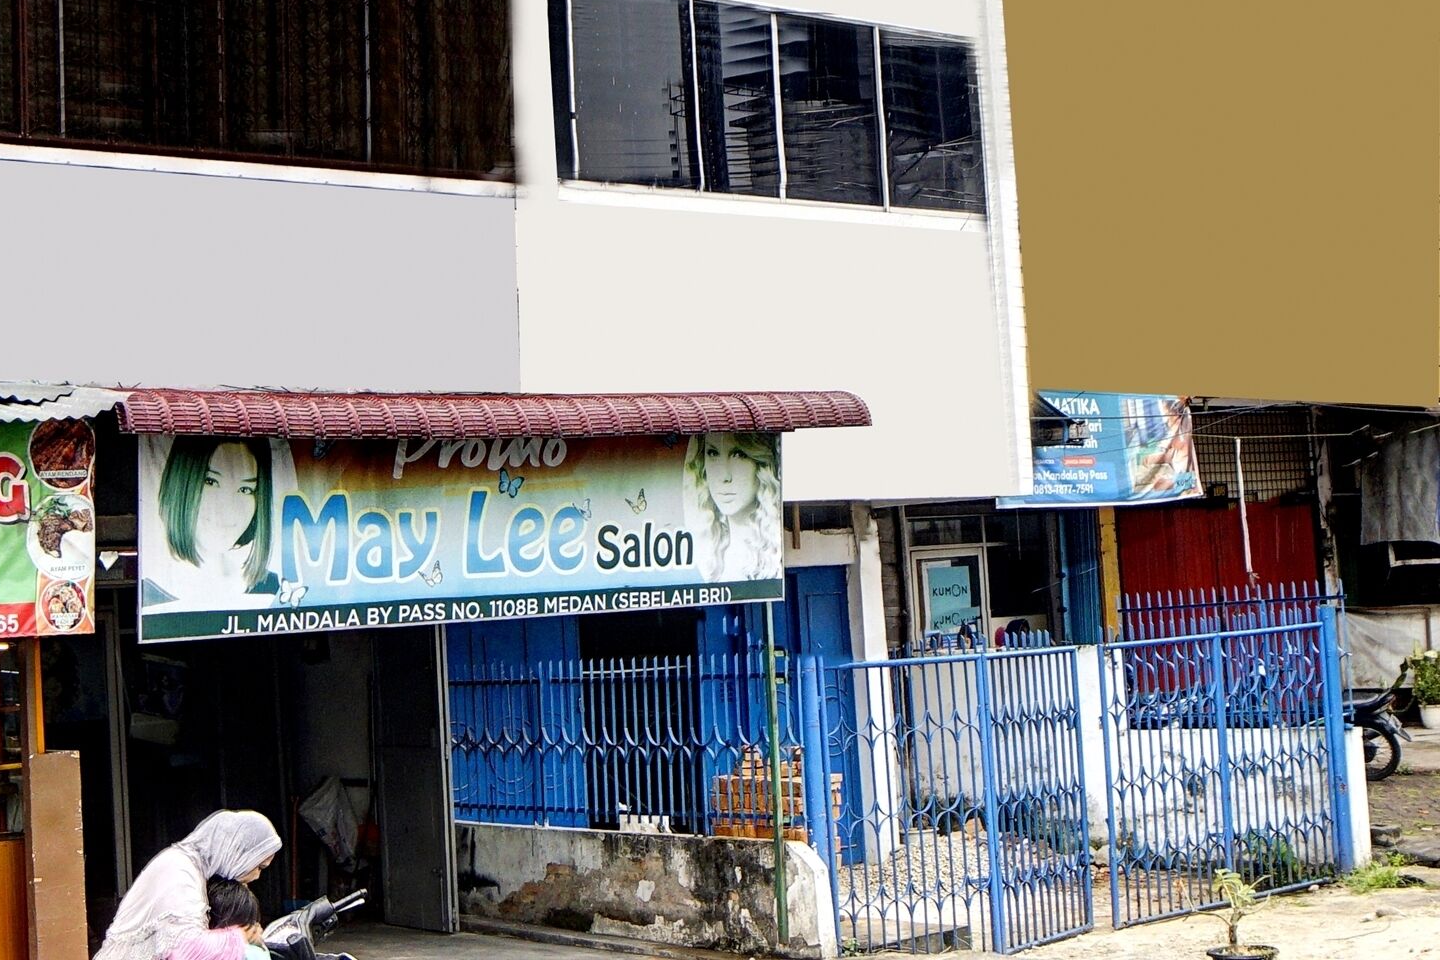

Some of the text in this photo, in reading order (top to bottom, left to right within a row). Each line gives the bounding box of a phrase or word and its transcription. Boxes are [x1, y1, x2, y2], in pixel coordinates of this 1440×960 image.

[1044, 397, 1101, 415] MATIKA
[279, 486, 589, 586] May Lee
[594, 522, 695, 570] Salon
[221, 586, 732, 634] JL. MANDALA BY PASS NO. 1108B MEDAN (SEBELAH BRI)
[932, 583, 968, 597] KUMON
